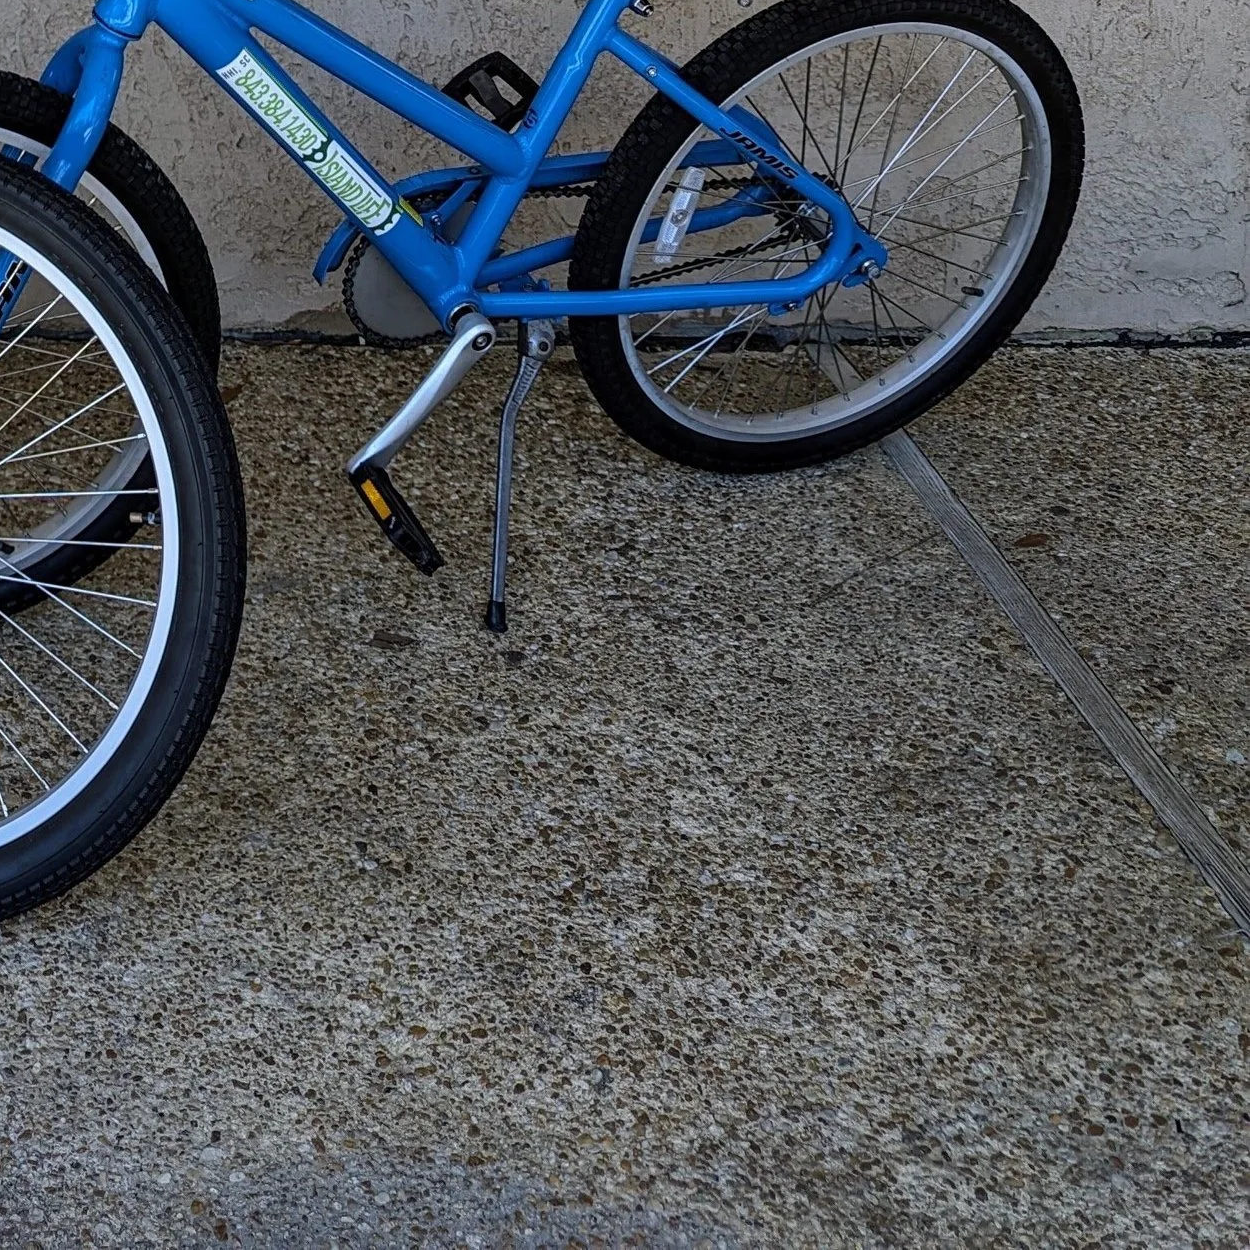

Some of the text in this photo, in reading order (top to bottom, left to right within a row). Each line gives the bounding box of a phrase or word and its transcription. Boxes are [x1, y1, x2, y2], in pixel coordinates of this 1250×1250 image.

[234, 68, 318, 151] 843.384.1430
[312, 149, 391, 225] ISLAND LIFE
[719, 127, 799, 180] JAMIS
